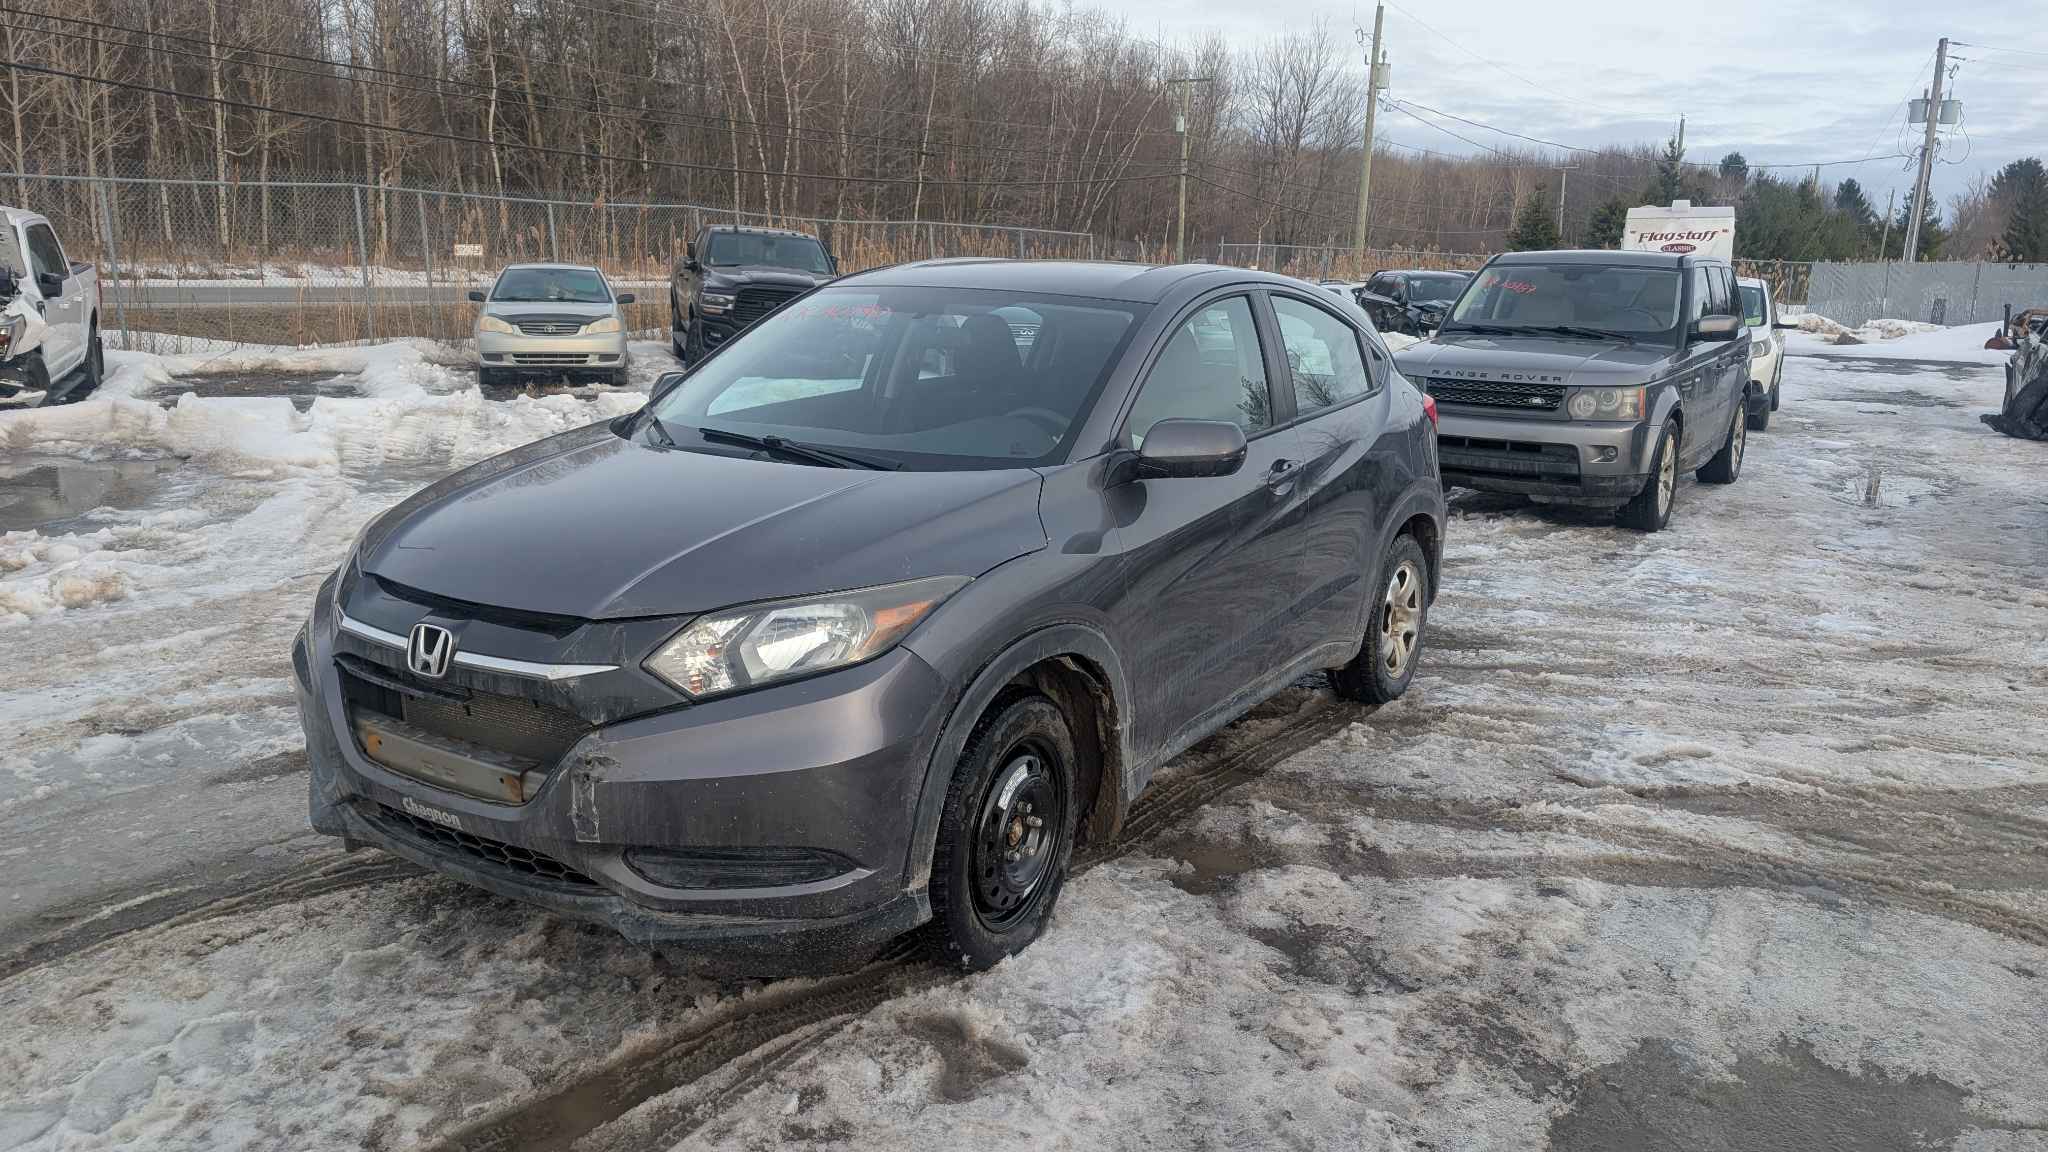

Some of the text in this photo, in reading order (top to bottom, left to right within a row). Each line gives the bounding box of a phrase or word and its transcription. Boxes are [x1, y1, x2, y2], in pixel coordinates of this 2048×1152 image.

[1638, 230, 1719, 243] Flagstaff
[1431, 369, 1562, 382] RANGE ROVER
